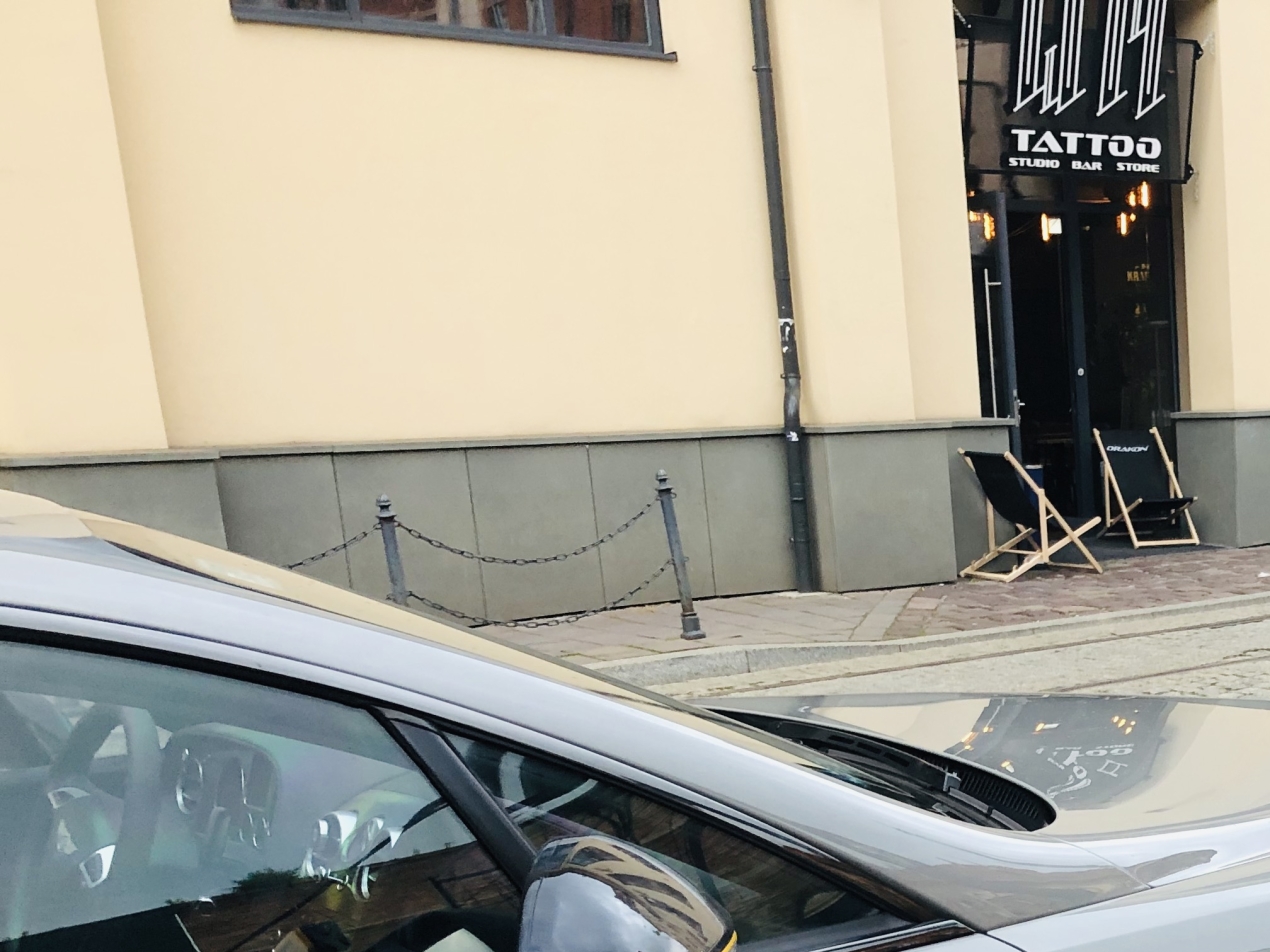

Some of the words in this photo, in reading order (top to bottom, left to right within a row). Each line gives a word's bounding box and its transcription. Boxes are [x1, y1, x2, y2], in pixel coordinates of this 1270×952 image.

[1011, 129, 1162, 160] TATTOO
[1008, 157, 1060, 169] STUDIO
[1071, 160, 1103, 171] BAR
[1116, 161, 1161, 174] STORE
[1106, 445, 1149, 453] DRAKON
